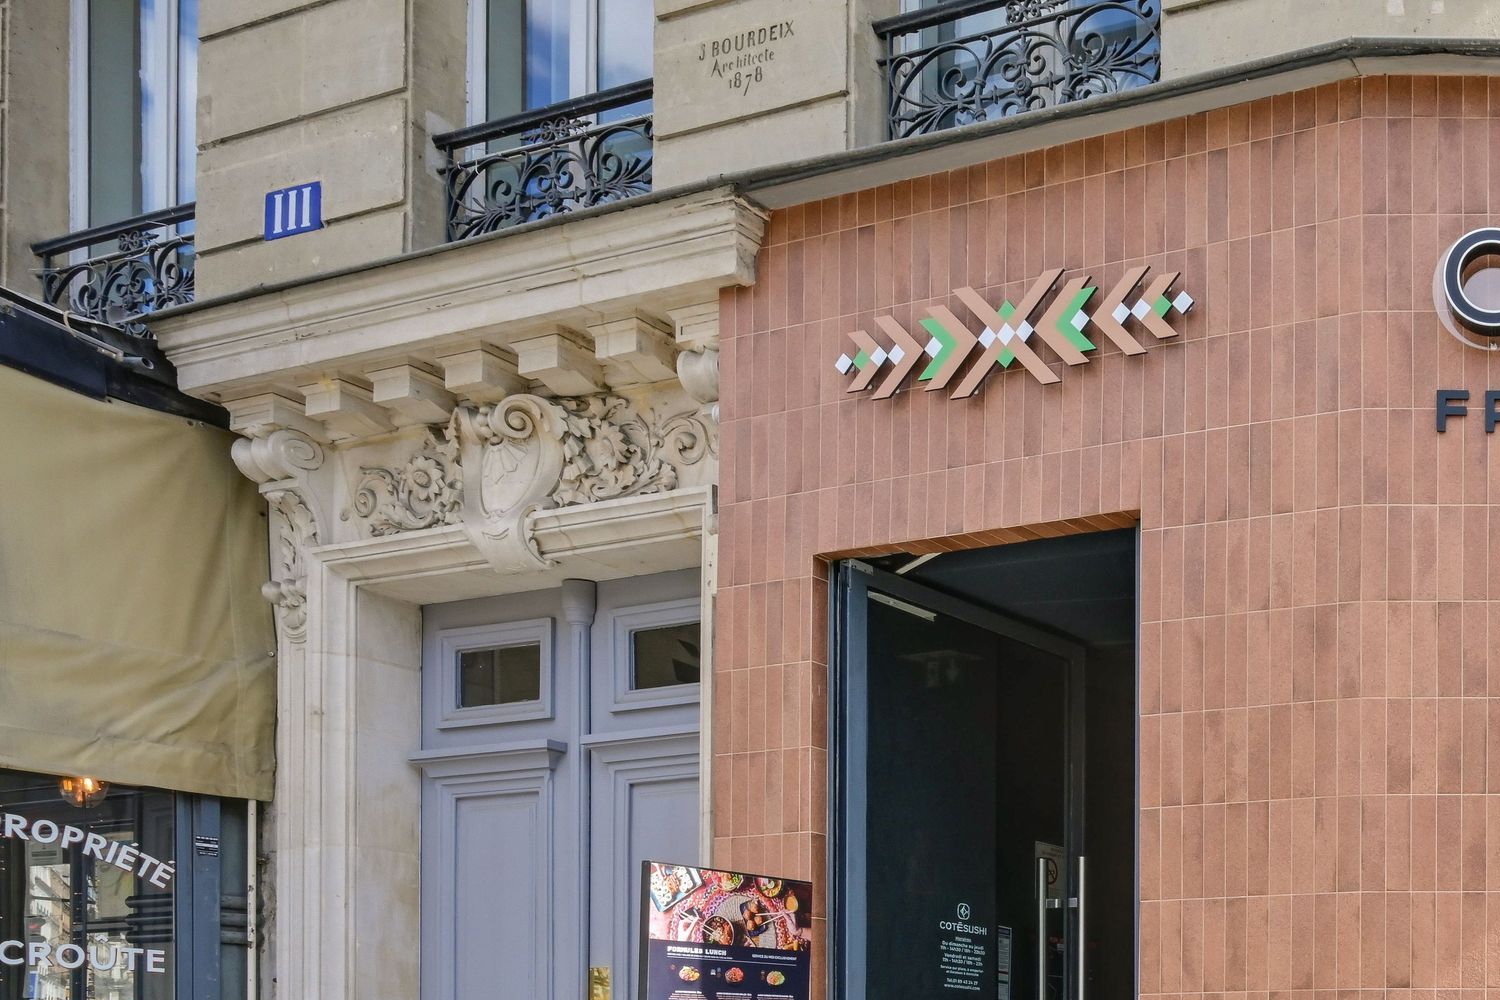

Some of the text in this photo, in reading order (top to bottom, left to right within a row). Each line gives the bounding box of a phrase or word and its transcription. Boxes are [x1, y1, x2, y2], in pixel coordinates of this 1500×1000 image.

[712, 20, 795, 57] BOURDEIX
[711, 48, 775, 78] Architecte
[729, 65, 763, 97] 1878
[0, 812, 176, 889] ROPRIÉTÉ
[0, 935, 166, 974] CROÛTE
[666, 945, 704, 955] FORMULES
[705, 948, 727, 956] LUNCH
